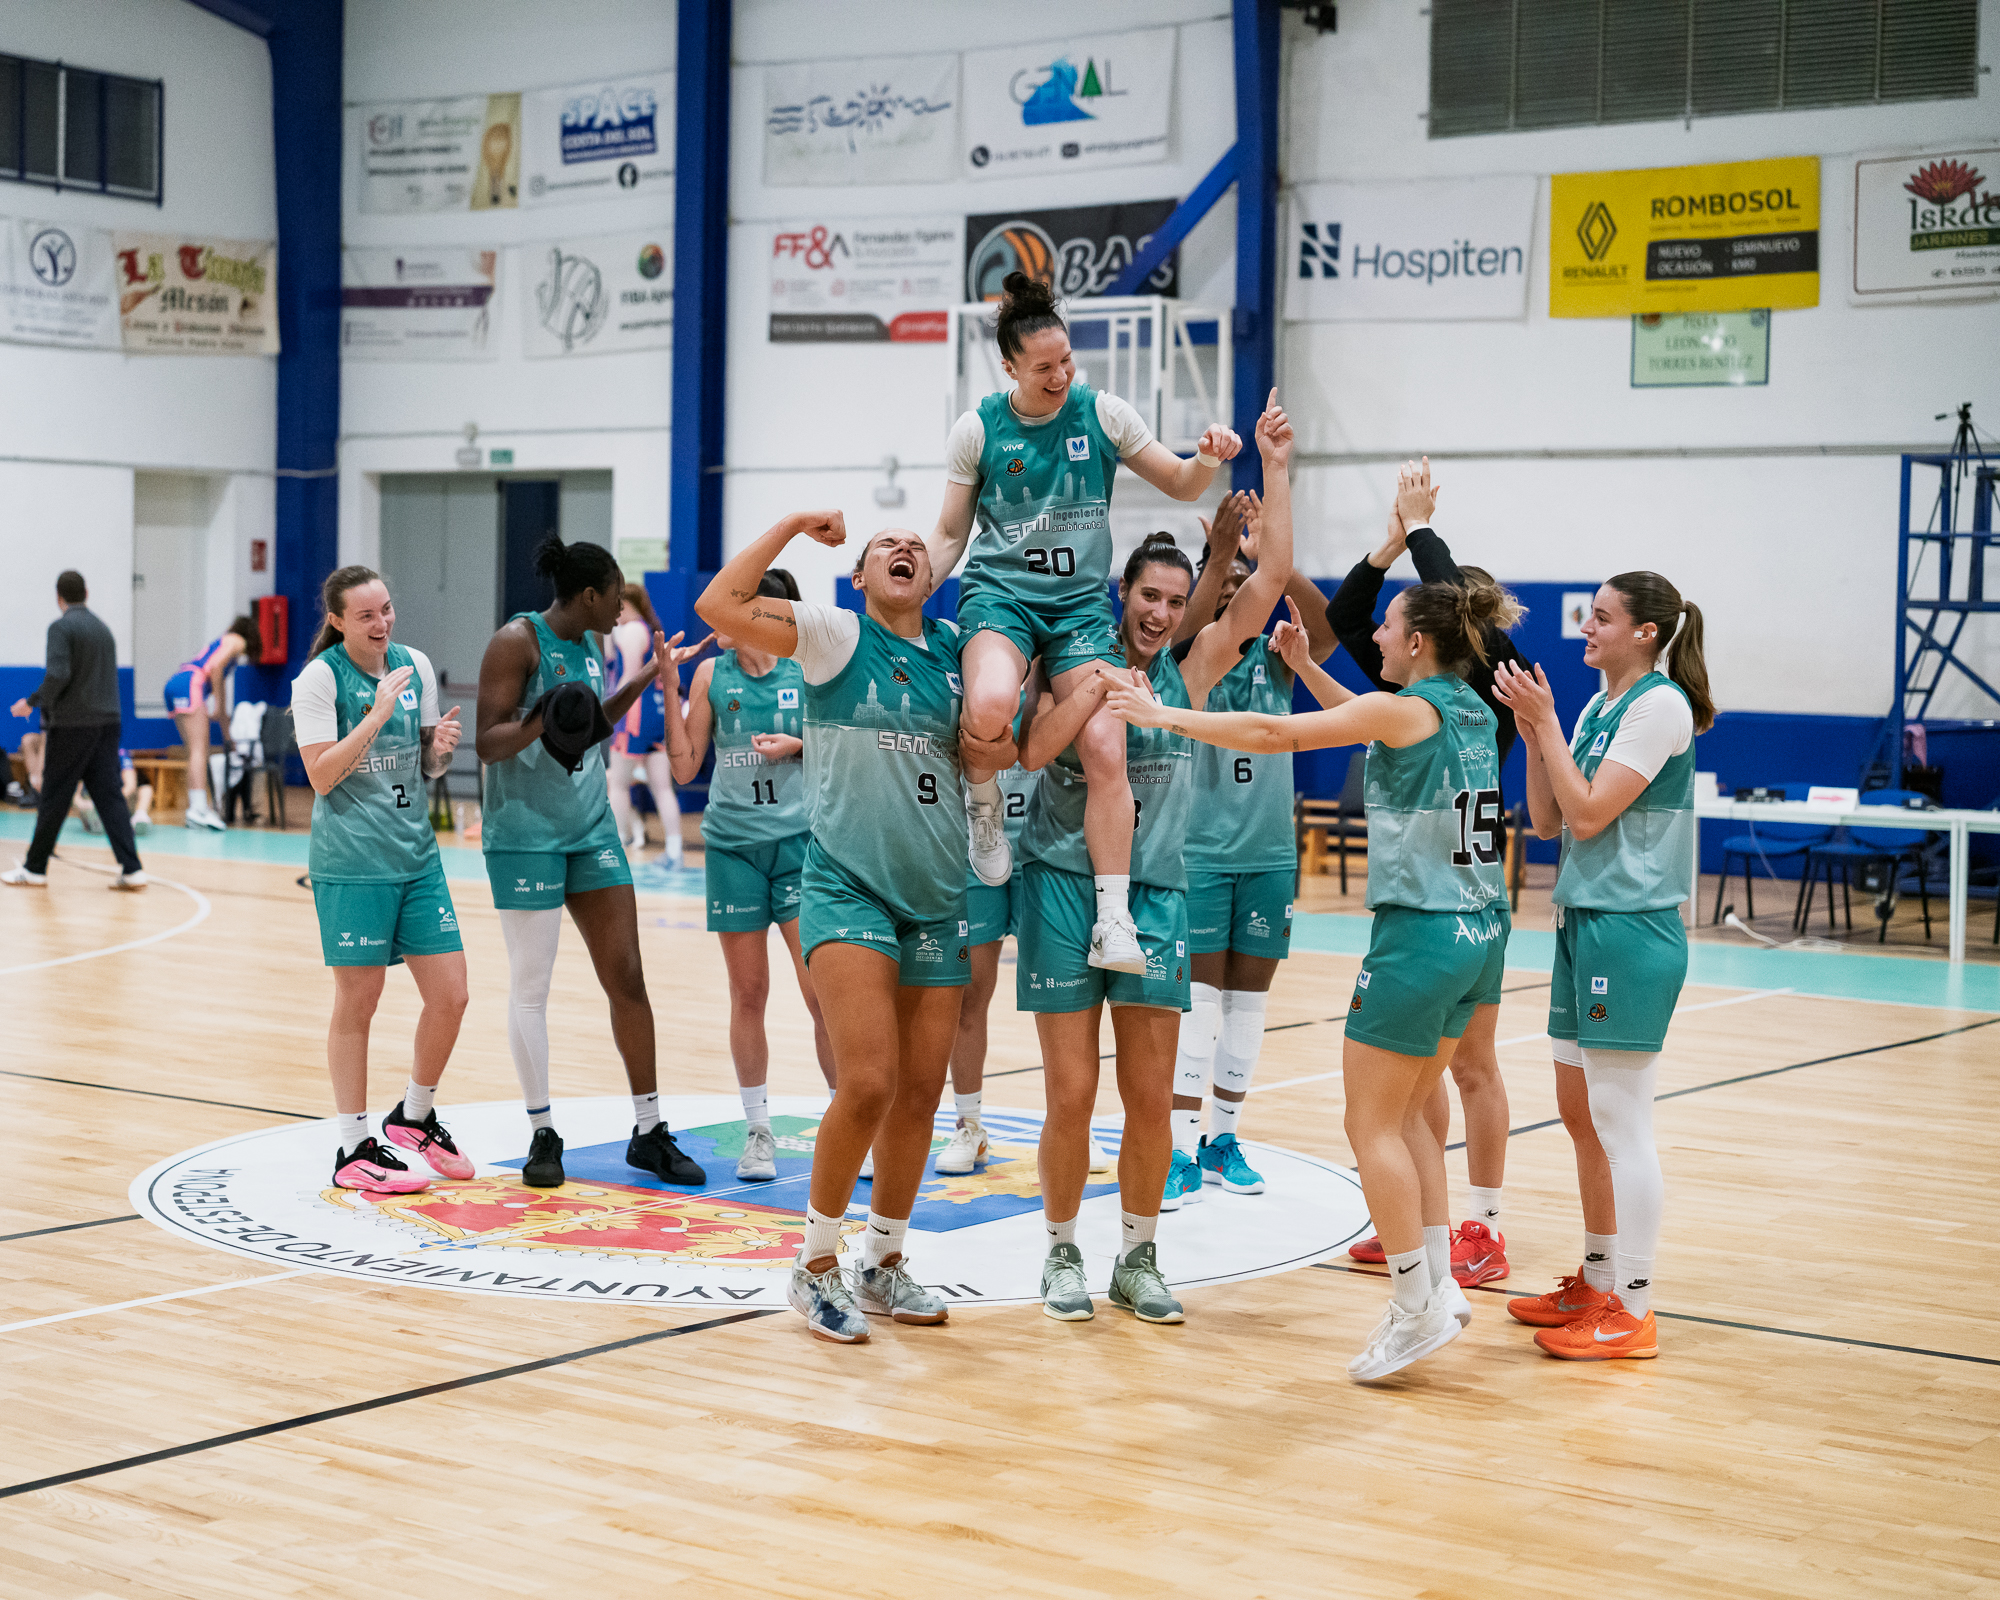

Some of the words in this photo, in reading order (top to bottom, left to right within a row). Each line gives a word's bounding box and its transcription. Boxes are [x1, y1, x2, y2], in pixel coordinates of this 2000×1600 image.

[1650, 188, 1801, 220] ROMBOSOL
[1658, 244, 1702, 259] NUEVO
[1731, 237, 1801, 256] SEMINUEVO
[1353, 239, 1523, 285] Hospiten
[1562, 264, 1629, 280] RENAULT
[1002, 443, 1024, 452] vive
[1052, 519, 1105, 532] ambiental
[1024, 546, 1076, 577] 20
[878, 730, 929, 755] SGM
[357, 755, 397, 773] SGM
[724, 751, 762, 767] SGM
[1234, 757, 1253, 784] 6
[392, 783, 411, 809] 2
[751, 779, 779, 805] 11
[917, 772, 939, 806] 9
[1006, 793, 1026, 818] 2
[1451, 788, 1499, 867] 15
[1190, 926, 1218, 935] Hospiten
[1056, 976, 1088, 988] Hospiten
[173, 1168, 254, 1224] ESTEPONA
[214, 1225, 299, 1242] DE
[275, 1242, 767, 1299] AYUNTAMIENTO
